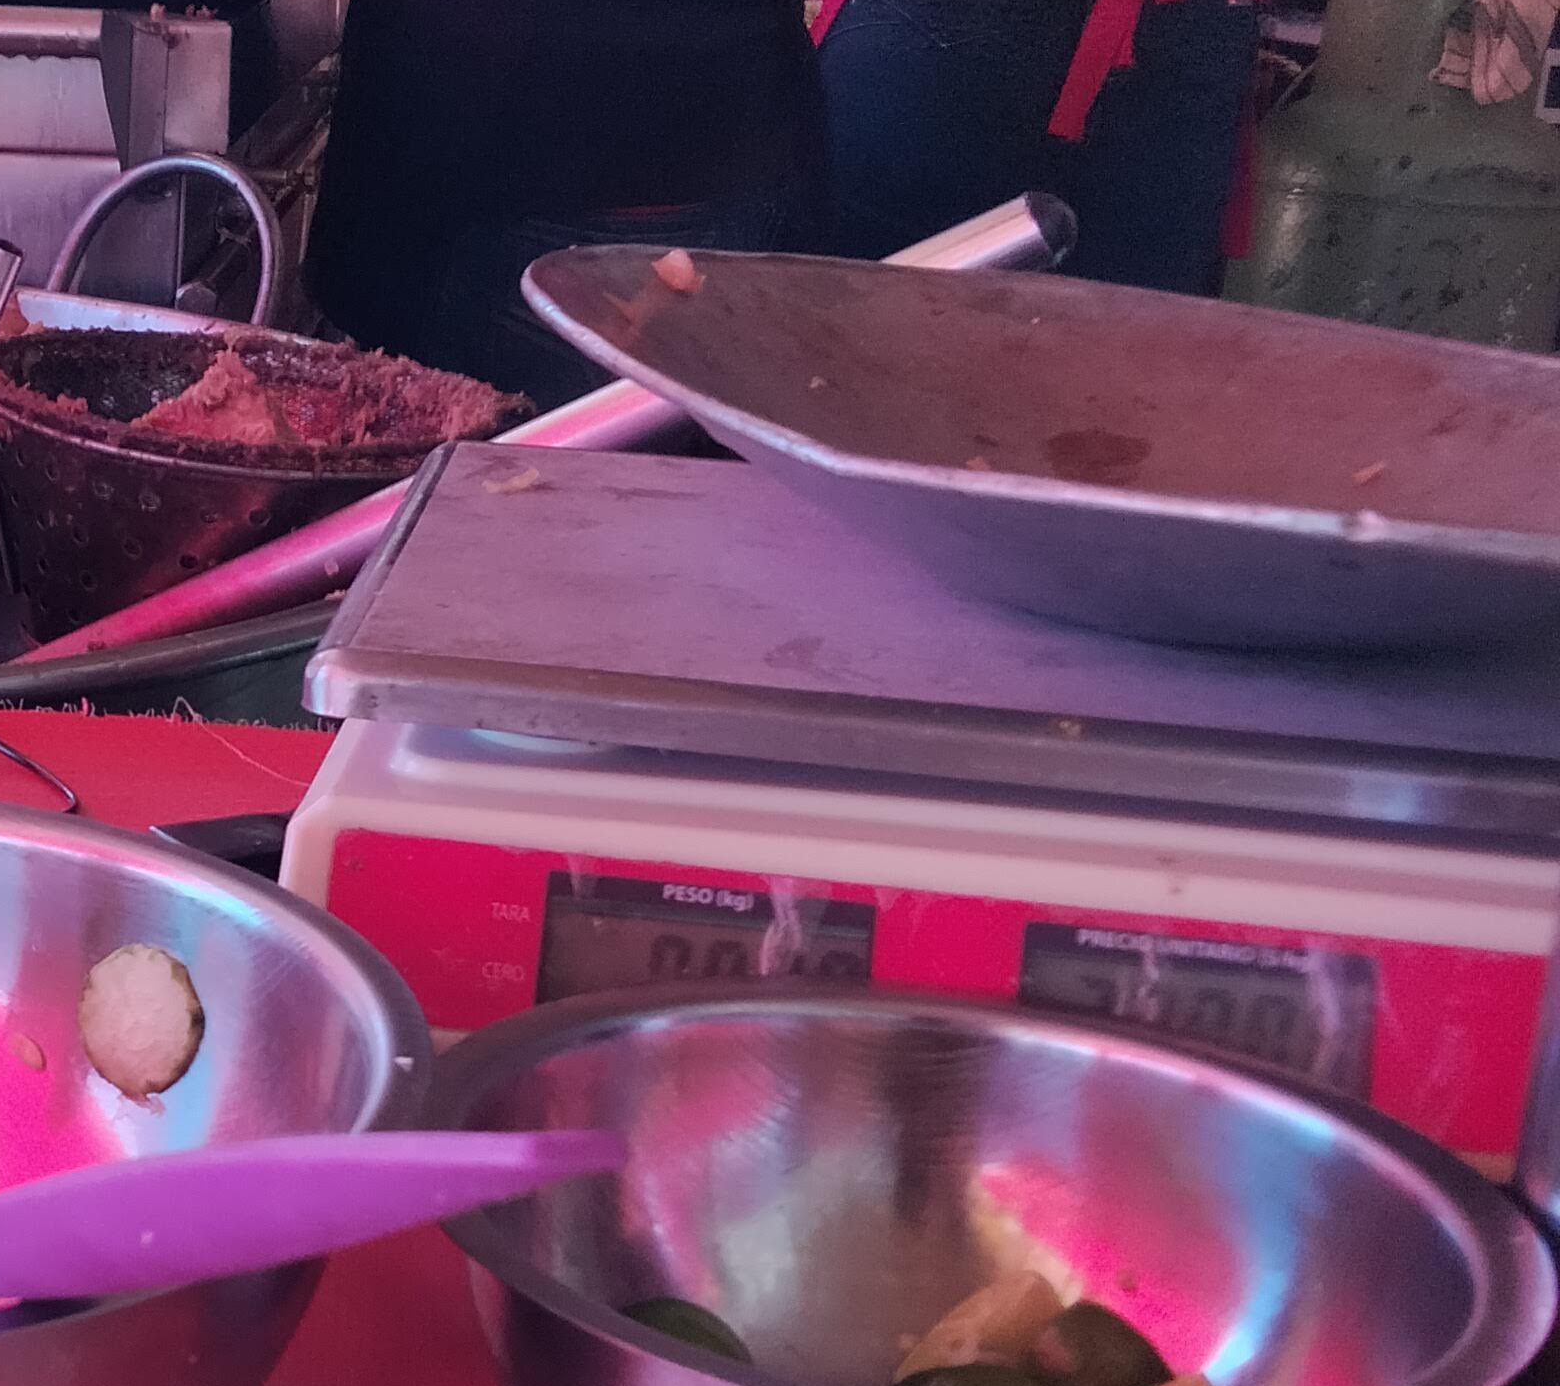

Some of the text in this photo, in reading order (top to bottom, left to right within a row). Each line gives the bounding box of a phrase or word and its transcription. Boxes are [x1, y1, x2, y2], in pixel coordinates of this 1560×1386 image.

[661, 883, 755, 912] PESO (kg)
[490, 901, 531, 923] TARA
[481, 961, 525, 982] CERO
